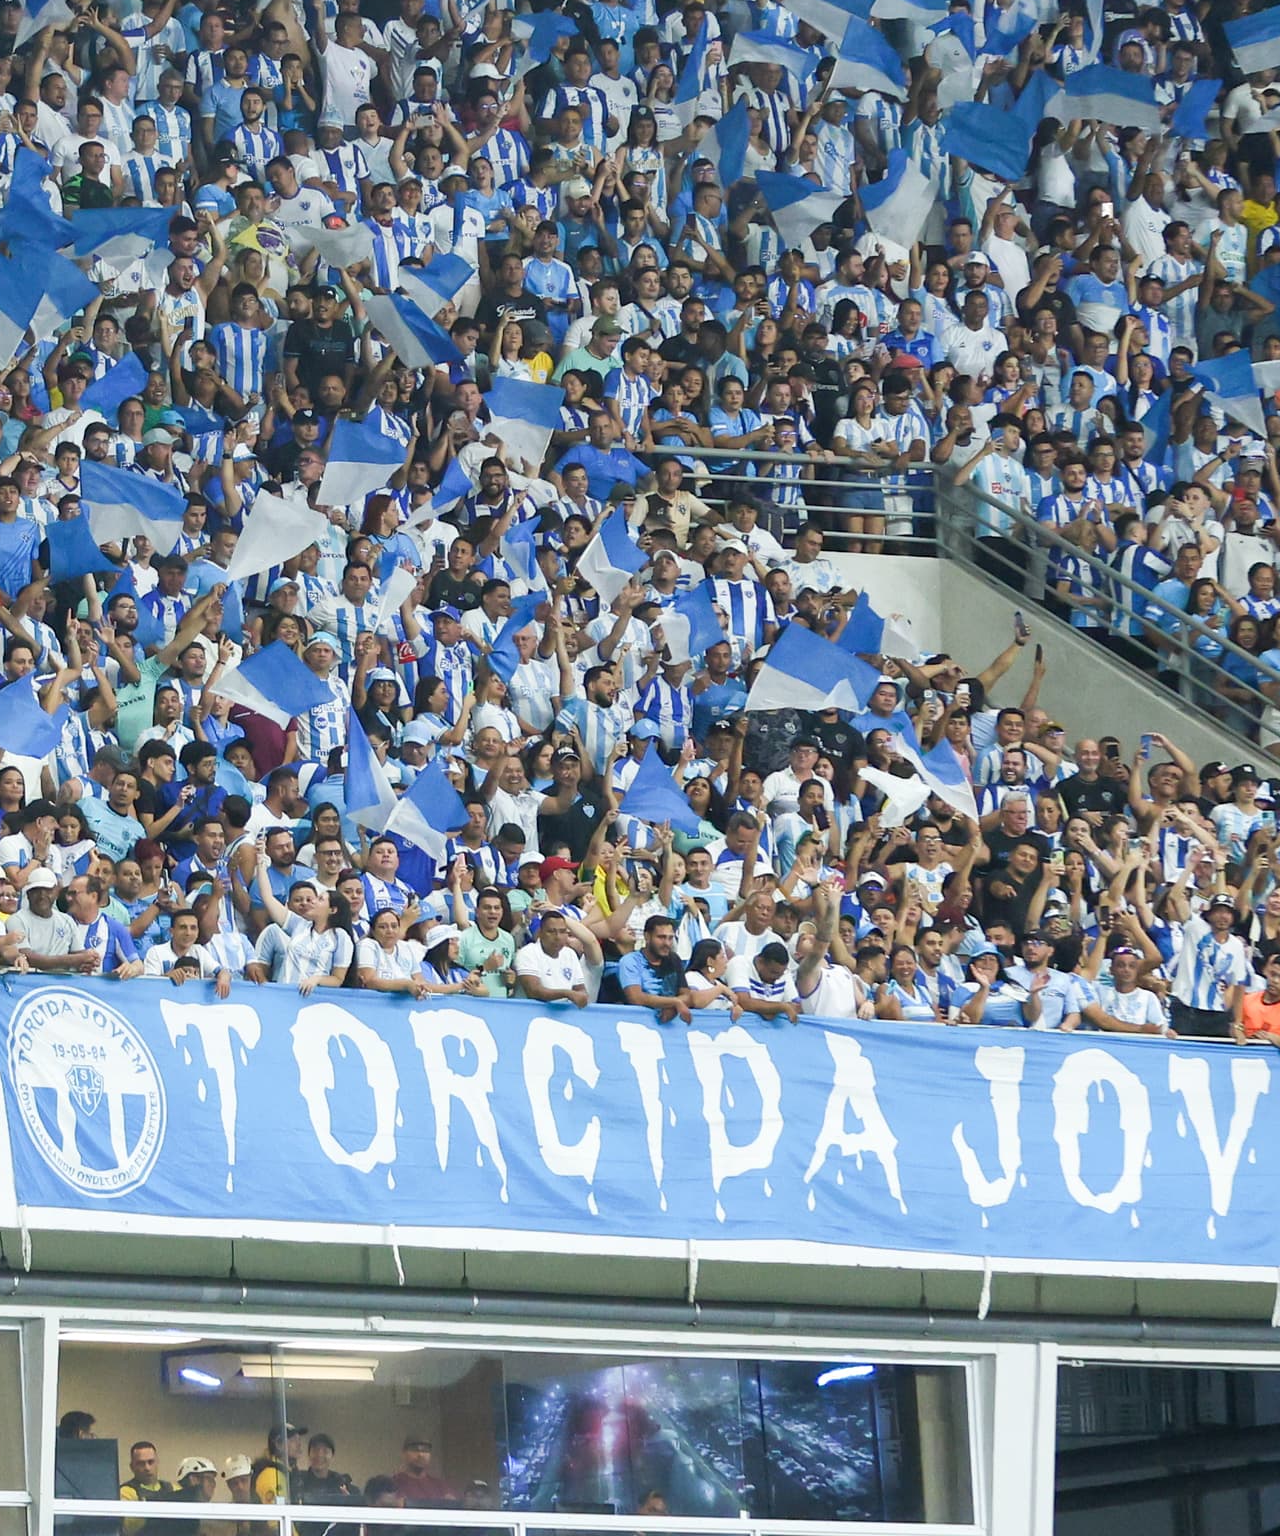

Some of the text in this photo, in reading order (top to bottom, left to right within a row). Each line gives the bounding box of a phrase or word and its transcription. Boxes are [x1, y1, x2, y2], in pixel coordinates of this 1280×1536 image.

[19, 999, 147, 1075] TORCIDA JOVEM
[159, 999, 908, 1221] TORCIDA
